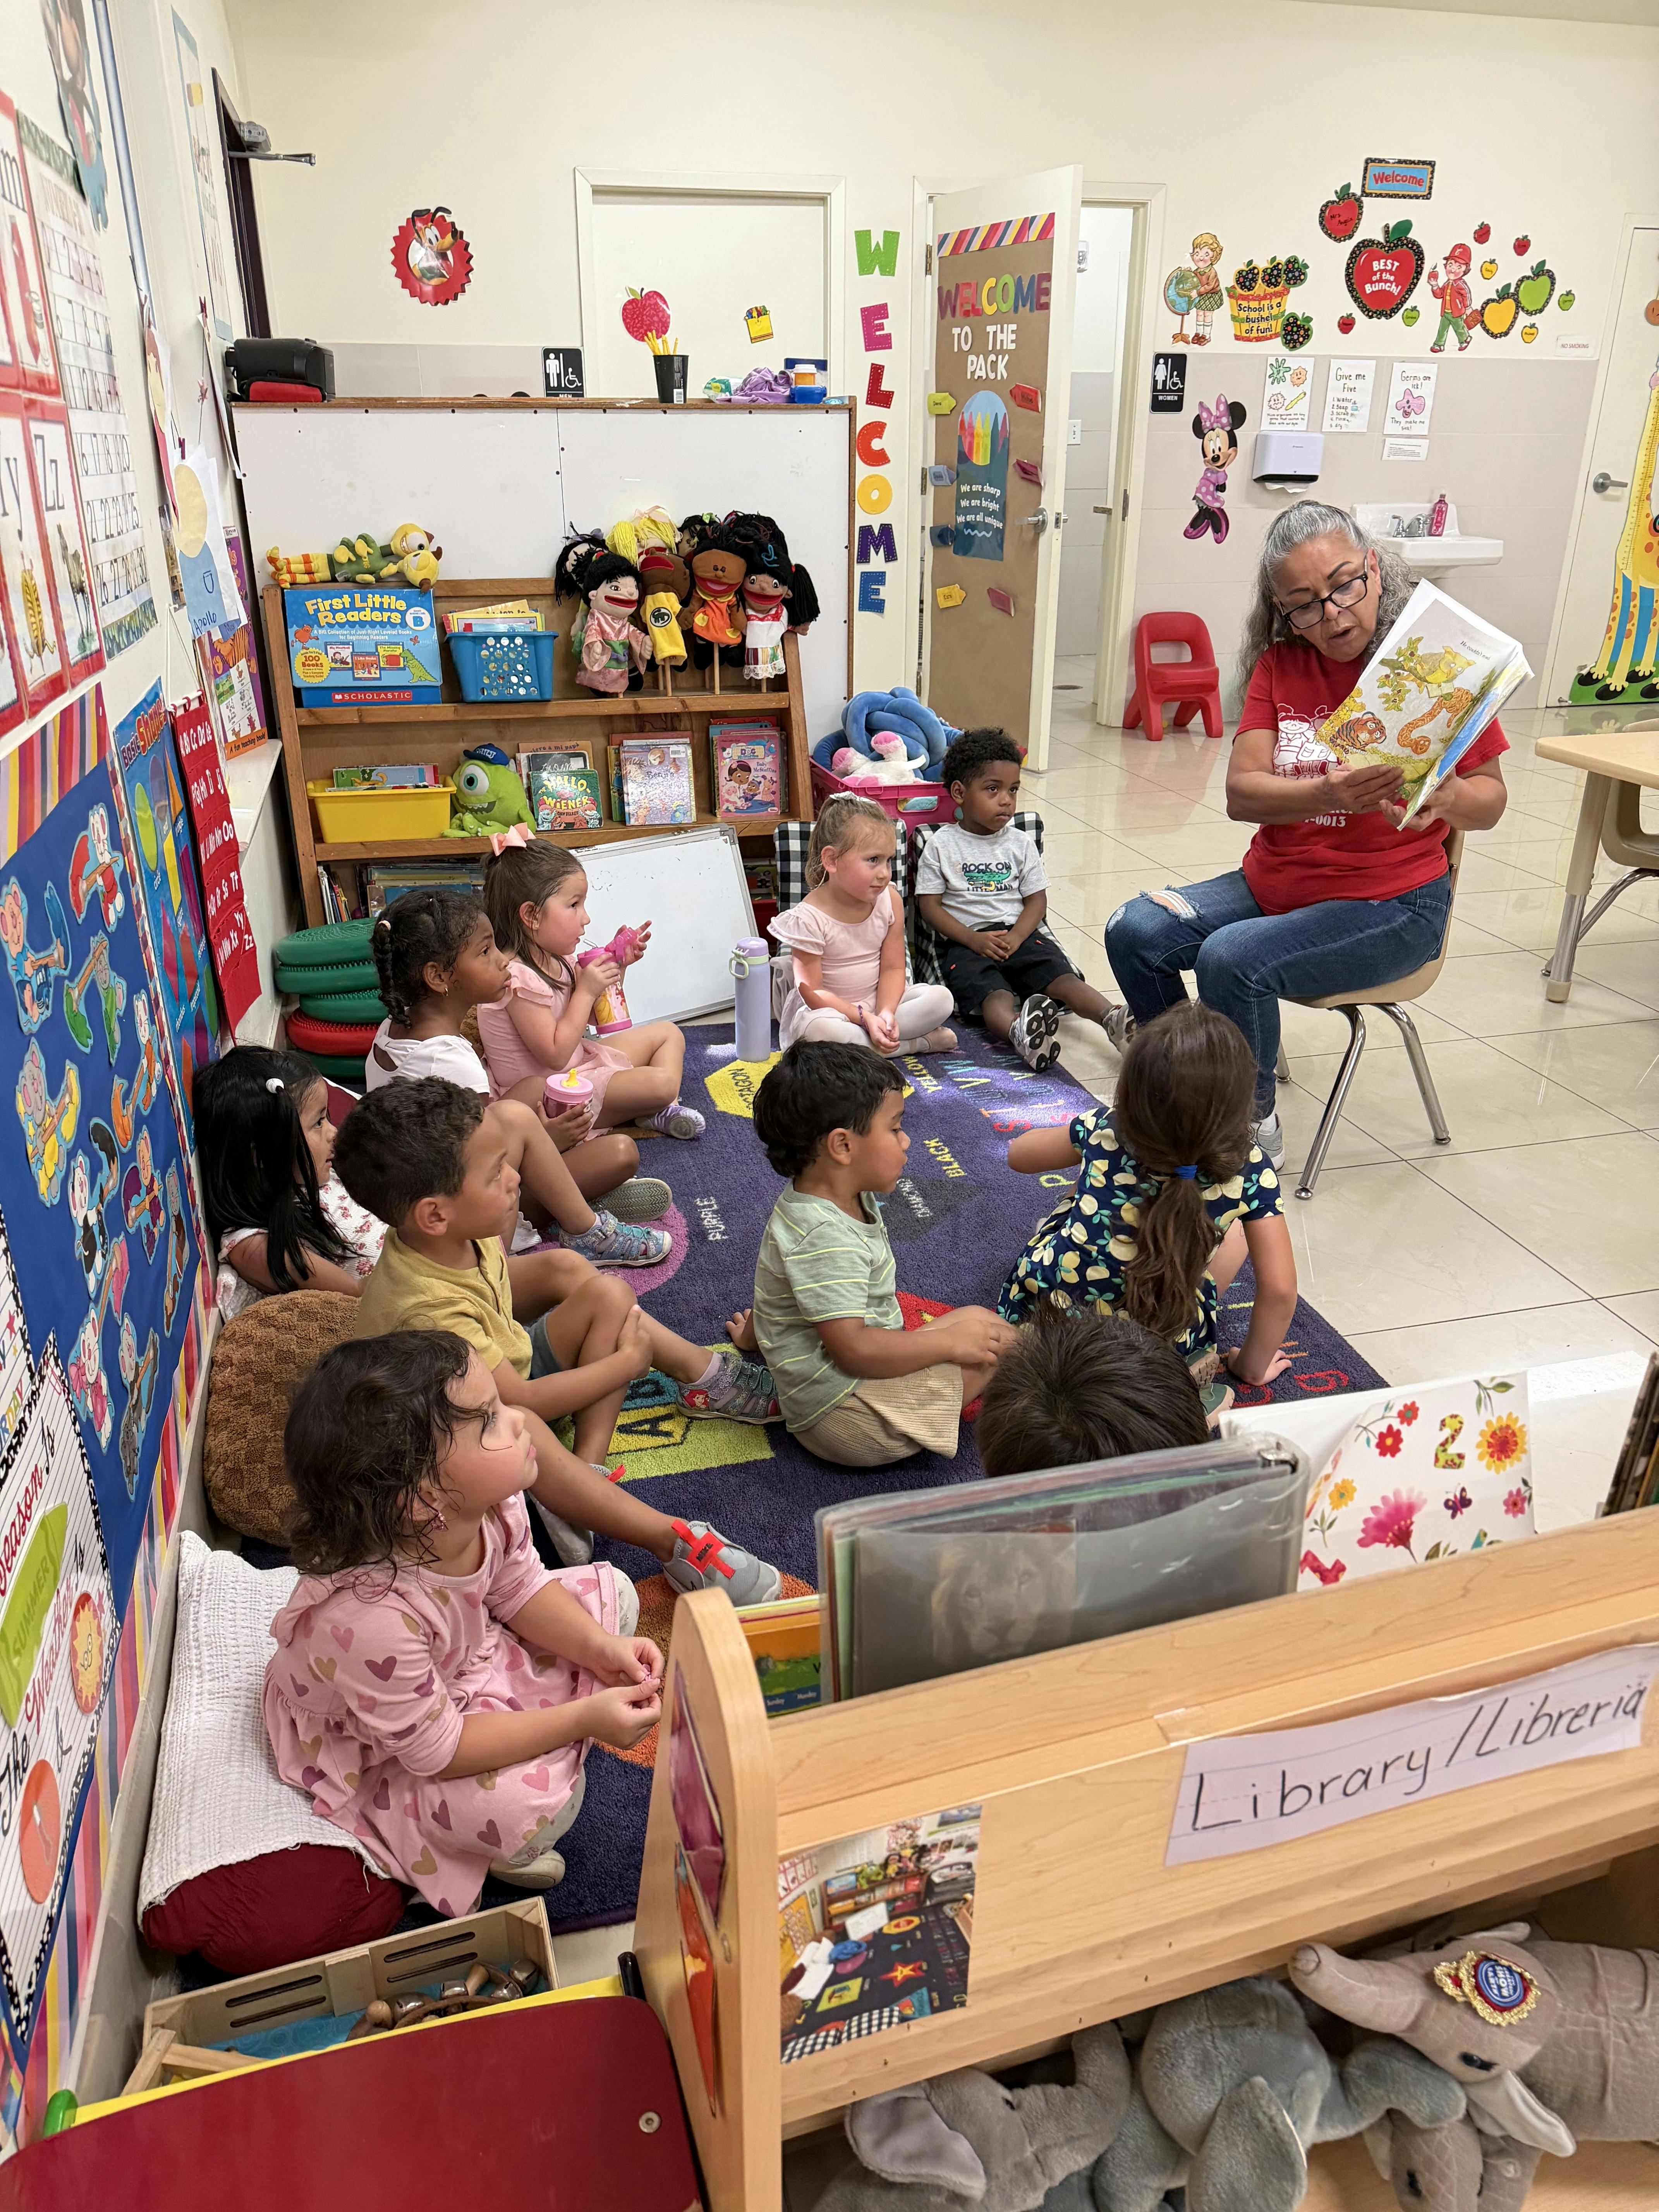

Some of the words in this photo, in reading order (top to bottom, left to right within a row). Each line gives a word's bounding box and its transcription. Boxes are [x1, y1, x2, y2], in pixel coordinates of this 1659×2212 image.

[1373, 170, 1424, 187] Welcome
[1372, 259, 1400, 271] BEST
[1372, 272, 1380, 281] of
[1382, 272, 1395, 281] the
[938, 273, 1051, 319] WELCOME
[1365, 282, 1401, 295] Bunch!
[1238, 304, 1265, 313] School
[1245, 313, 1273, 323] bushel
[1245, 326, 1254, 334] of
[1256, 324, 1273, 334] fun!
[952, 326, 972, 352] TO
[986, 324, 1017, 350] THE
[967, 354, 1009, 380] PACK
[1336, 368, 1352, 381] Give
[1401, 371, 1421, 381] Germs
[1343, 383, 1357, 392] Five
[853, 229, 900, 614] WELCOME
[1391, 417, 1401, 426] They
[34, 434, 65, 512] Zz
[960, 484, 970, 493] We
[983, 483, 1001, 498] sharp
[960, 499, 969, 508] We
[982, 497, 999, 511] bright
[957, 514, 965, 523] We
[984, 515, 1003, 529] unique
[305, 594, 351, 615] First
[354, 594, 407, 611] Little
[193, 610, 217, 635] Apollo
[317, 608, 402, 626] Readers
[412, 616, 424, 627] B
[344, 692, 411, 701] SCHOLASTIC
[198, 721, 206, 747] Dd
[121, 732, 141, 771] Basic
[230, 745, 233, 754] A
[242, 737, 256, 750] teaching
[222, 820, 234, 842] Oo
[996, 861, 1012, 871] ON
[230, 871, 239, 892] Tt
[234, 911, 244, 930] Yy
[244, 933, 254, 951] Zz
[923, 1137, 967, 1178] BLACK
[694, 1196, 729, 1240] PURPLE
[616, 1413, 675, 1438] A
[1494, 1965, 1510, 1997] SHOW
